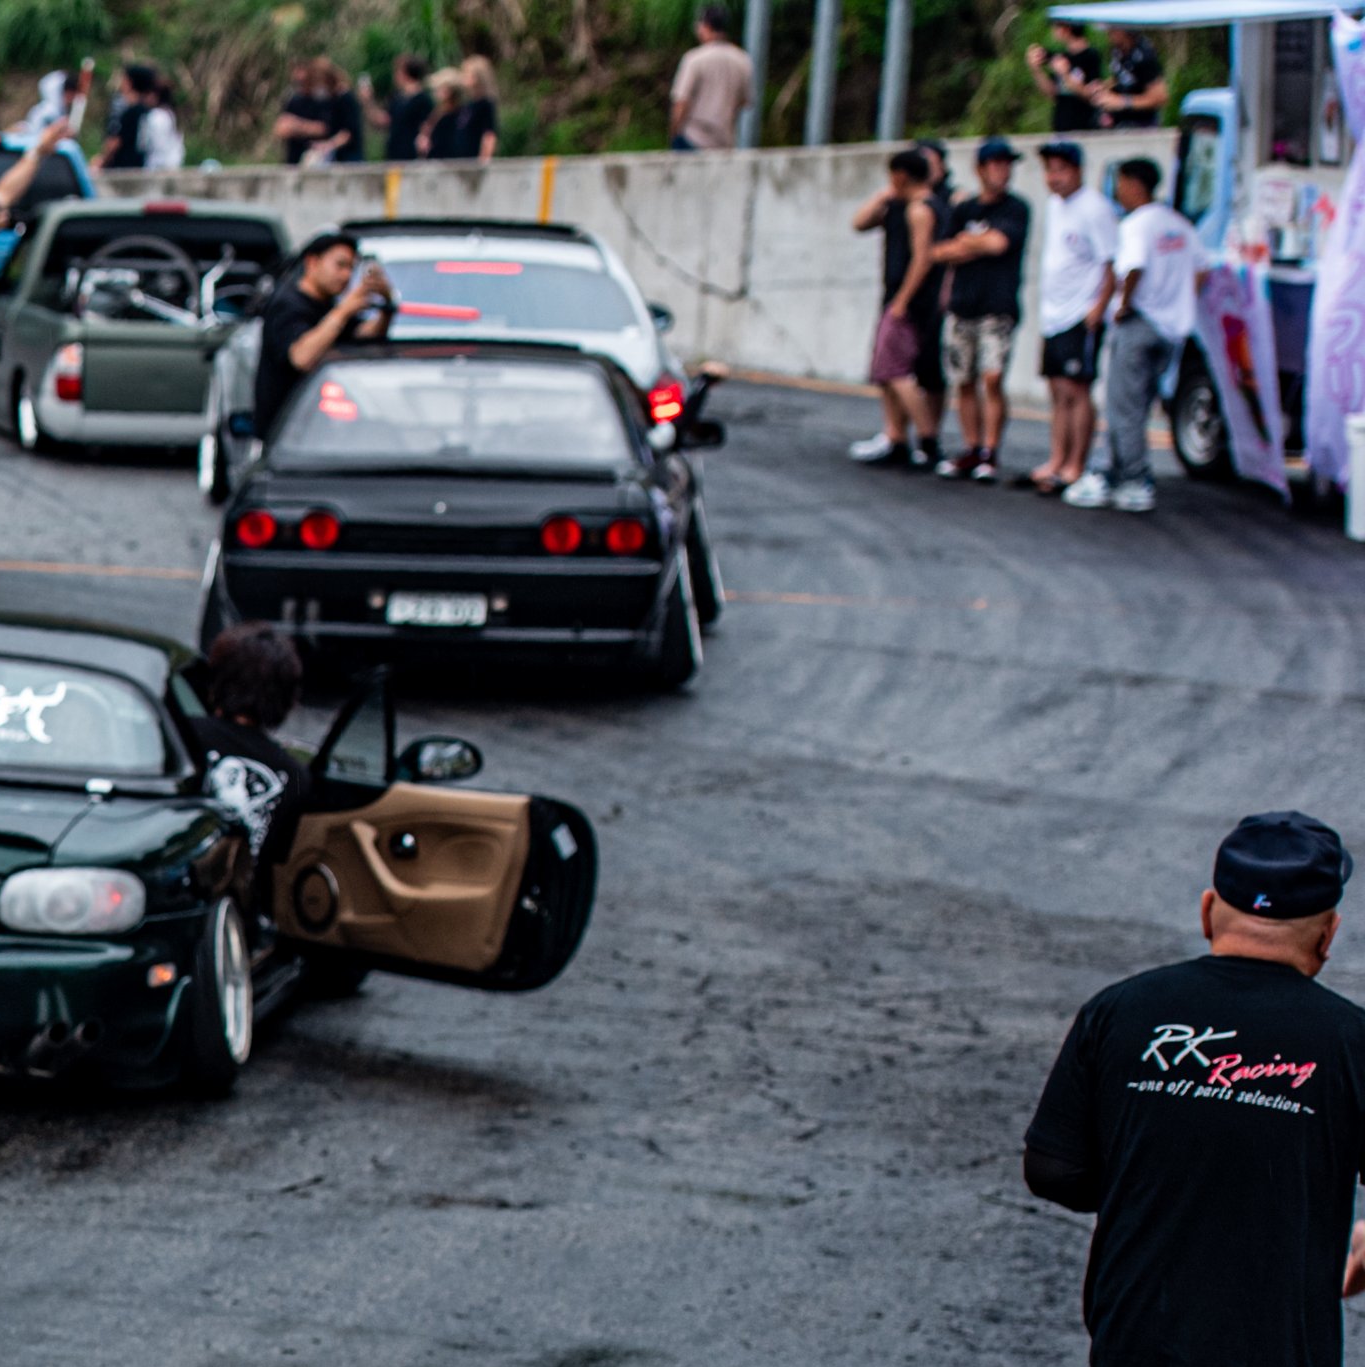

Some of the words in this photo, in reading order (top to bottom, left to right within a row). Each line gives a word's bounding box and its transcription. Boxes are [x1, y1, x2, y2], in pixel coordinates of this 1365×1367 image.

[1141, 1023, 1238, 1072] RK
[1207, 1053, 1318, 1089] Racing
[1168, 1078, 1194, 1097] off
[1194, 1084, 1234, 1101] parts
